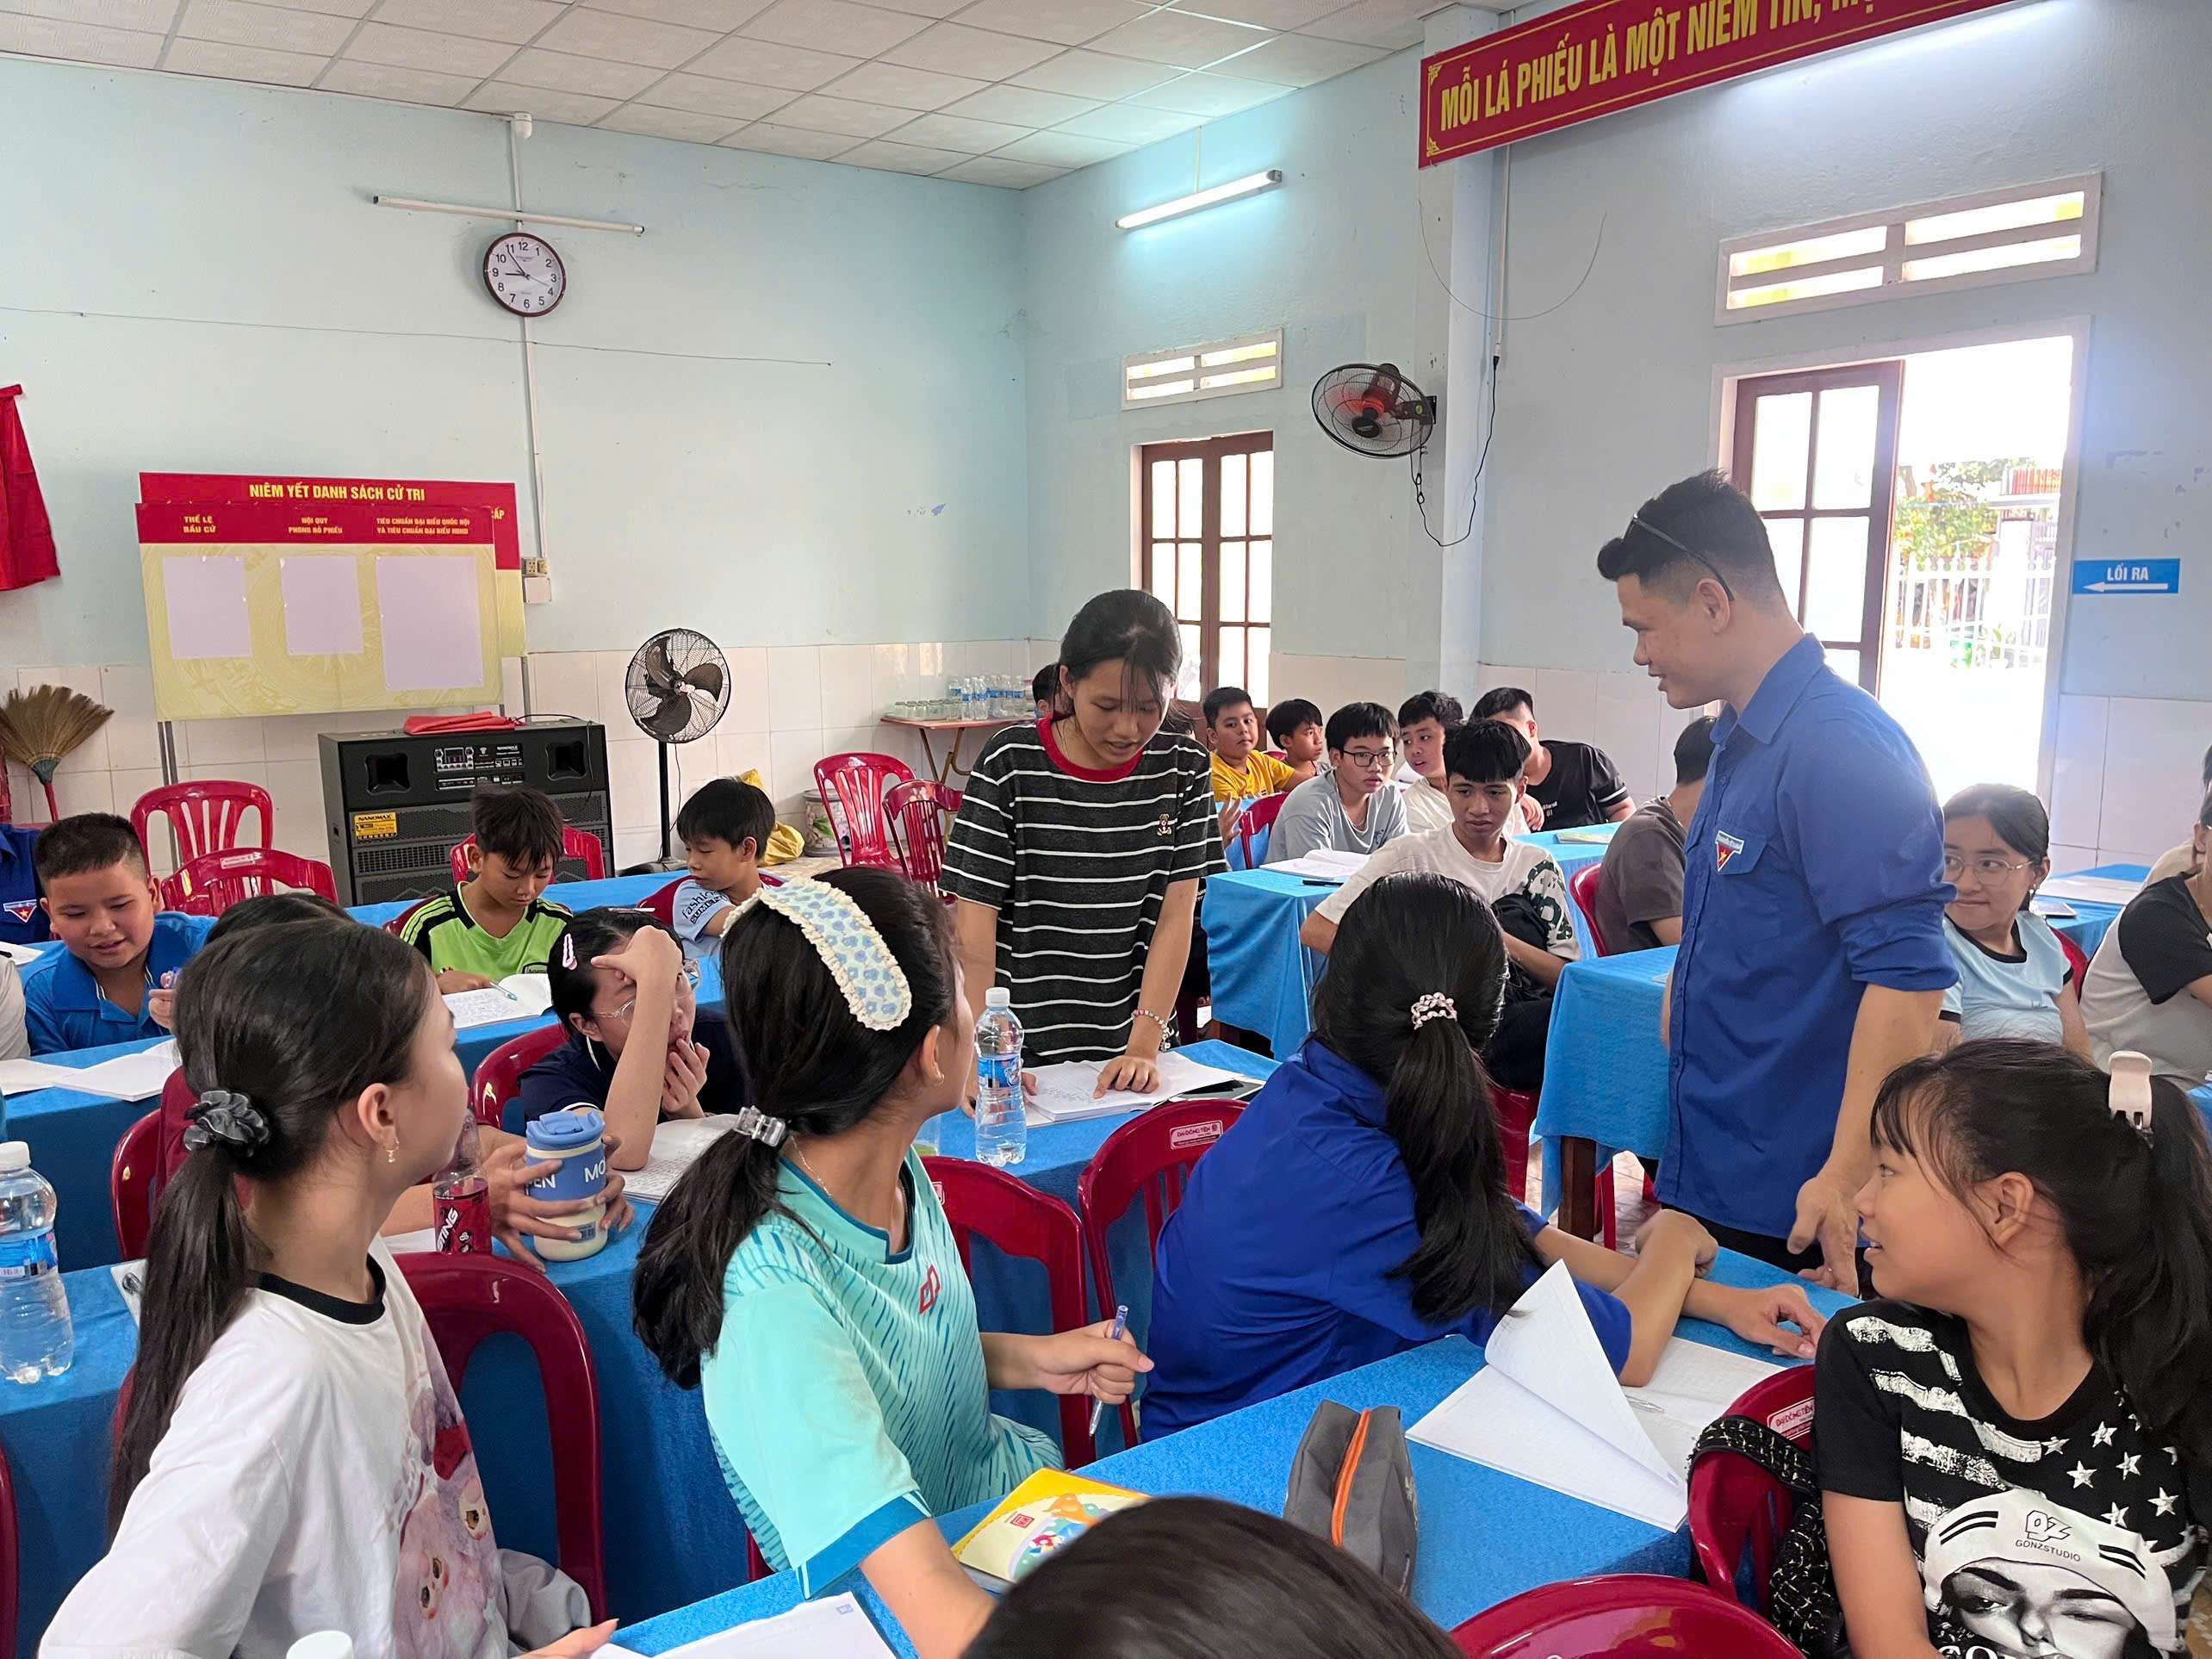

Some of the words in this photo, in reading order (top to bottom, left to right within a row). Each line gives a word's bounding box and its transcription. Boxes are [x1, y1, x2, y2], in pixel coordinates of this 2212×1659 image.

[1441, 65, 1480, 131] MỖI
[1485, 59, 1510, 118] LÁ
[1517, 33, 1583, 108] PHIẾU
[1589, 23, 1618, 85] LÀ
[1625, 7, 1681, 77] MỘT
[518, 241, 529, 251] 12
[496, 254, 506, 263] 10
[545, 258, 552, 267] 2
[492, 268, 499, 276] 9
[550, 273, 557, 283] 3
[498, 283, 505, 292] 8
[548, 288, 554, 296] 4
[509, 293, 516, 302] 7
[538, 296, 545, 306] 5
[524, 299, 531, 308] 6
[249, 482, 283, 498] NIÊM
[287, 482, 309, 499] YẾT
[313, 486, 347, 499] DANH
[351, 484, 384, 500] SÁCH
[406, 488, 426, 500] TRI
[2107, 562, 2128, 581] LỐI
[2131, 567, 2149, 581] RA
[437, 1208, 459, 1252] STING
[2015, 1539, 2081, 1562] GONZSTUDIO
